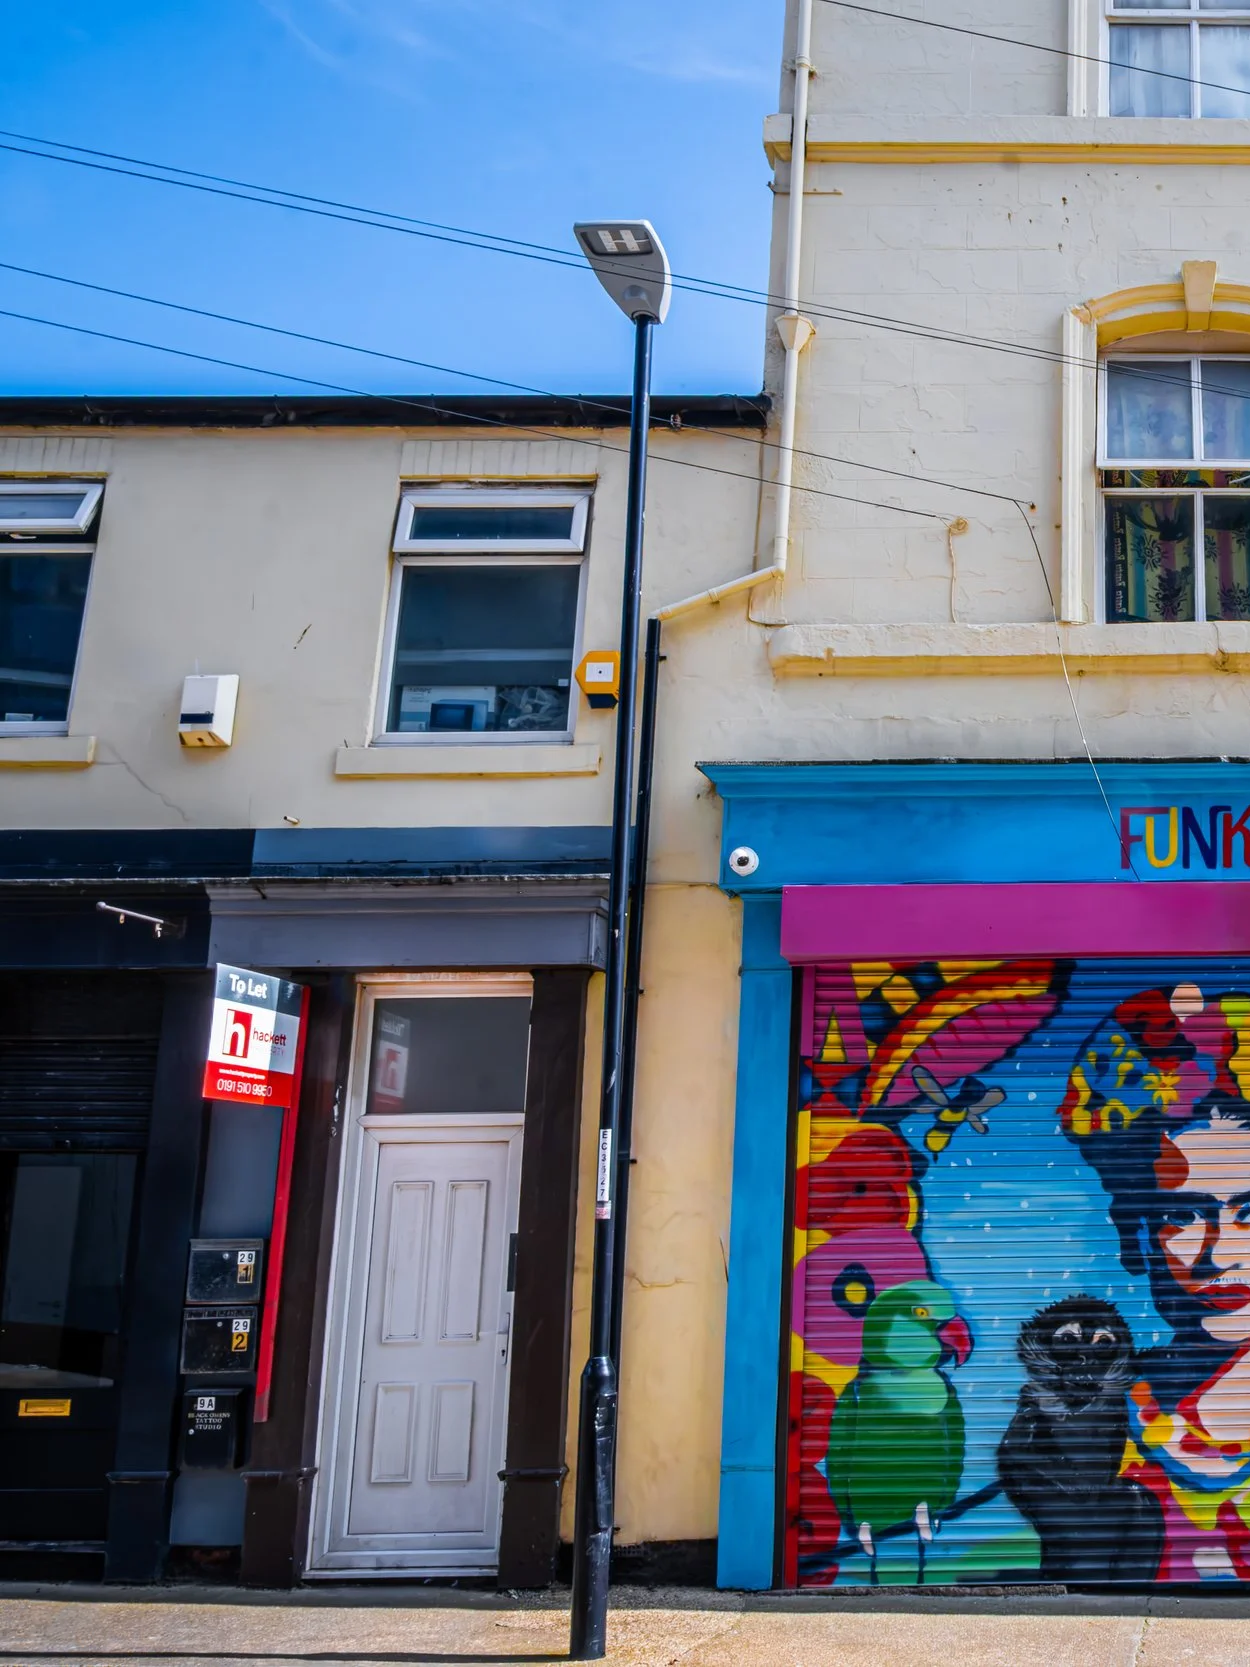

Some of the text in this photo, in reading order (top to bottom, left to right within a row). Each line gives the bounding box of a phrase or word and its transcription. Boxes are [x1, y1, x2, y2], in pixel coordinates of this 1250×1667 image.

[229, 973, 268, 999] To Let
[253, 1027, 287, 1047] hackett
[216, 1078, 273, 1097] 0191 510 9950
[239, 1253, 254, 1263] 29
[233, 1320, 249, 1331] 29
[233, 1333, 246, 1350] 2
